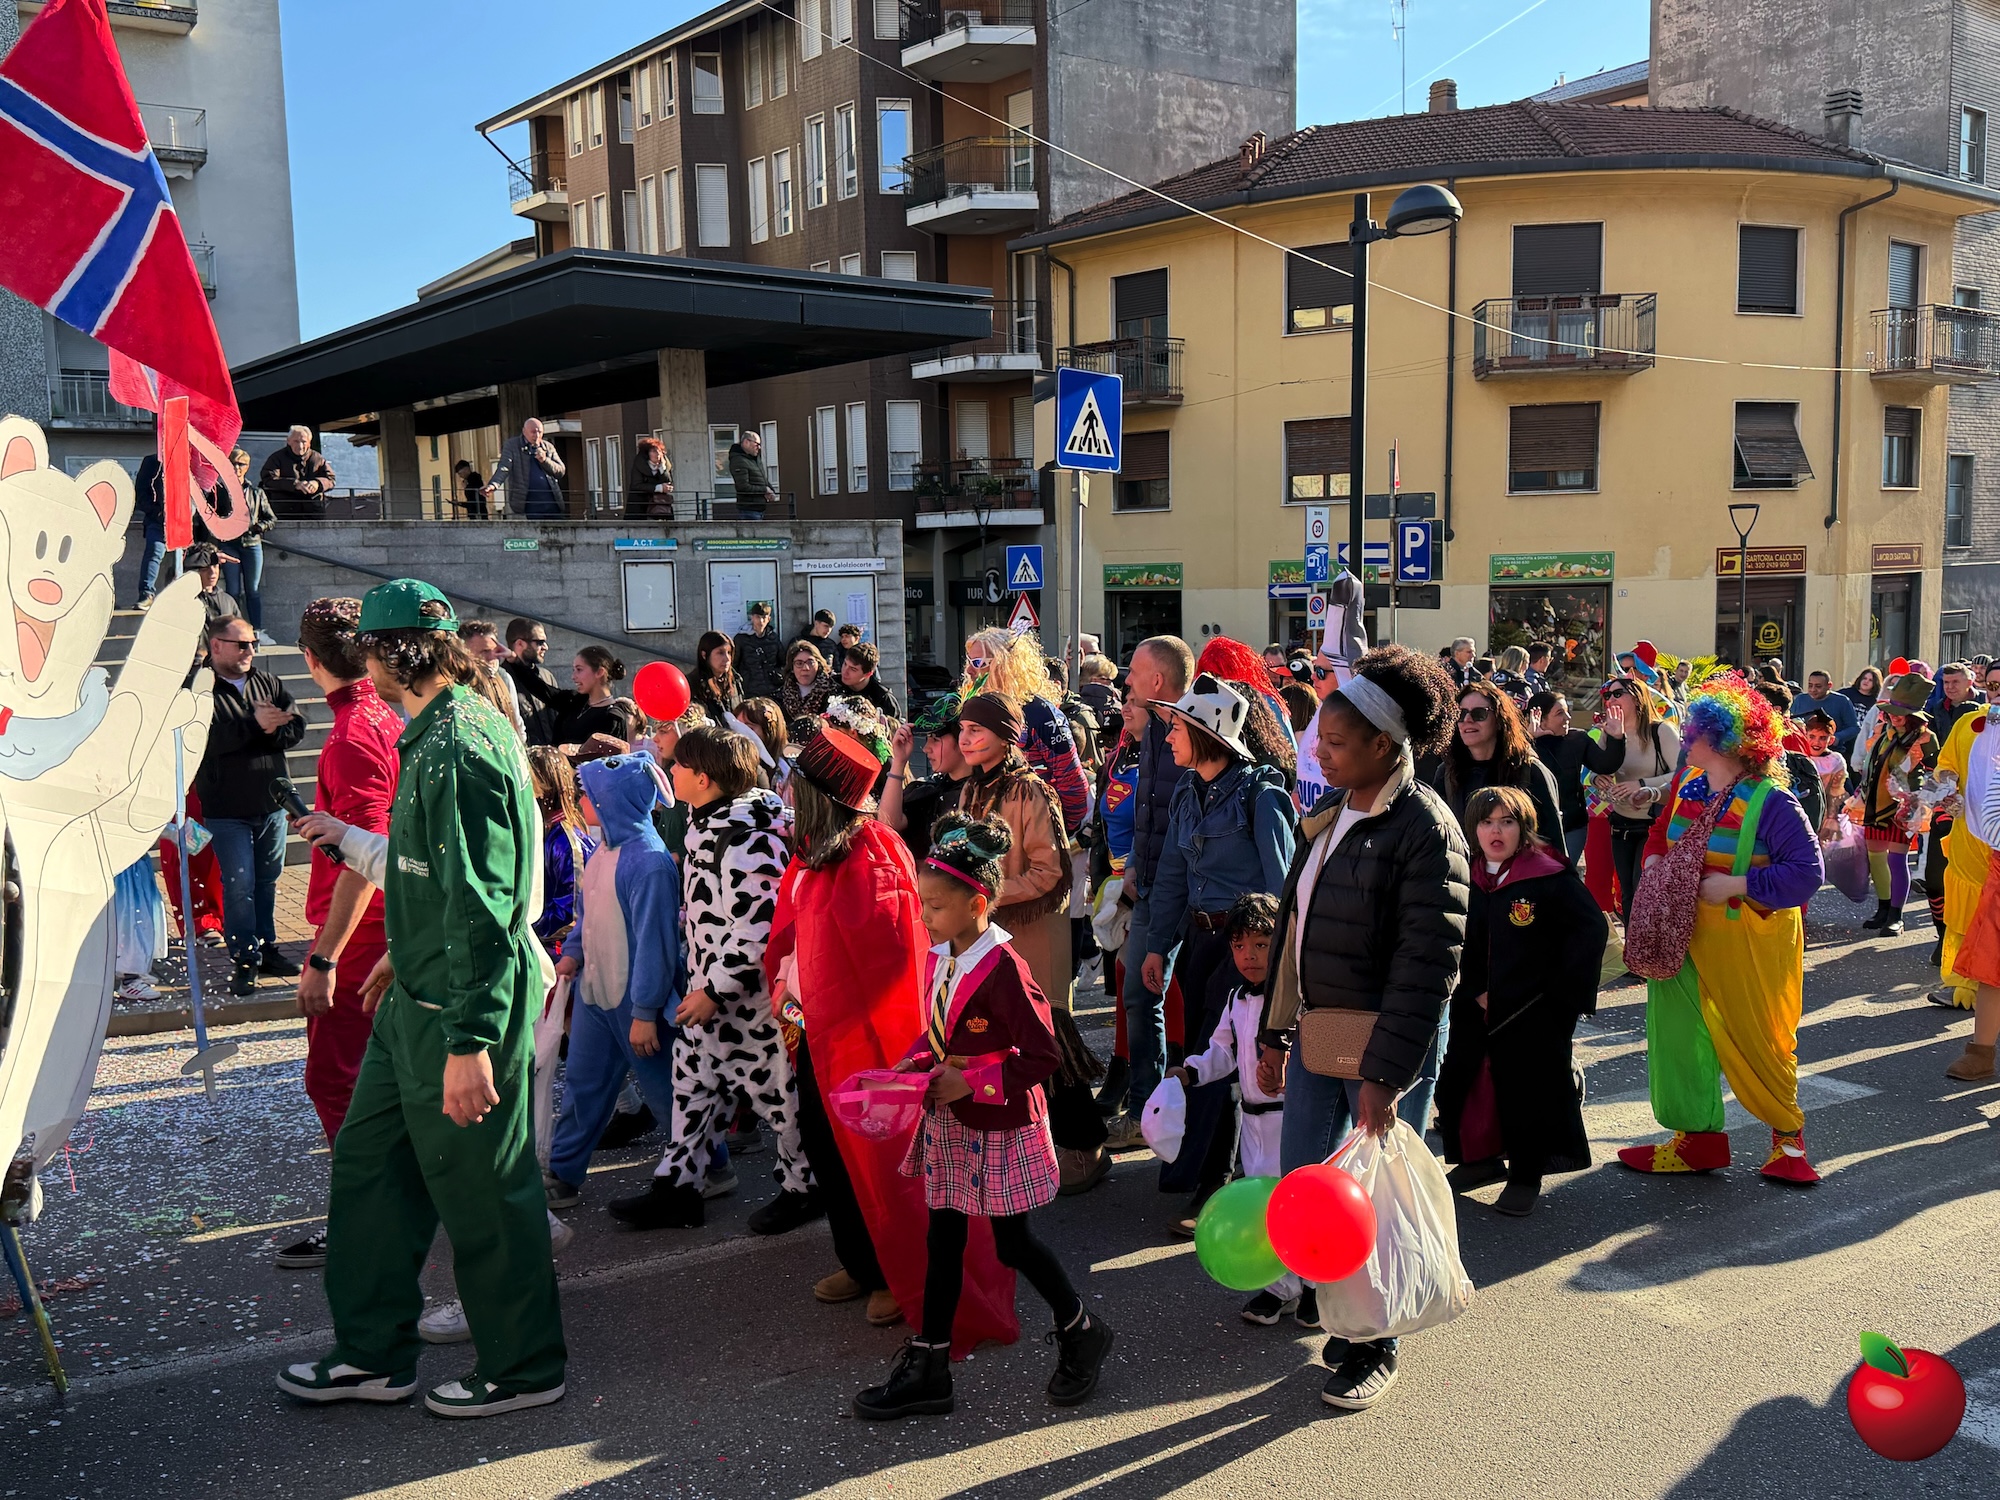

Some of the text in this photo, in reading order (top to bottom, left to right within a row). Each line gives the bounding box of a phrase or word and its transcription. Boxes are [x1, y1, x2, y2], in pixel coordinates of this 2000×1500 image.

[1315, 525, 1321, 533] 30
[633, 539, 654, 547] A.C.T.
[1405, 526, 1425, 558] P
[1746, 553, 1802, 562] SARTORIA CALOLZIO
[1050, 732, 1073, 746] 2026
[1337, 1056, 1359, 1065] GUESS
